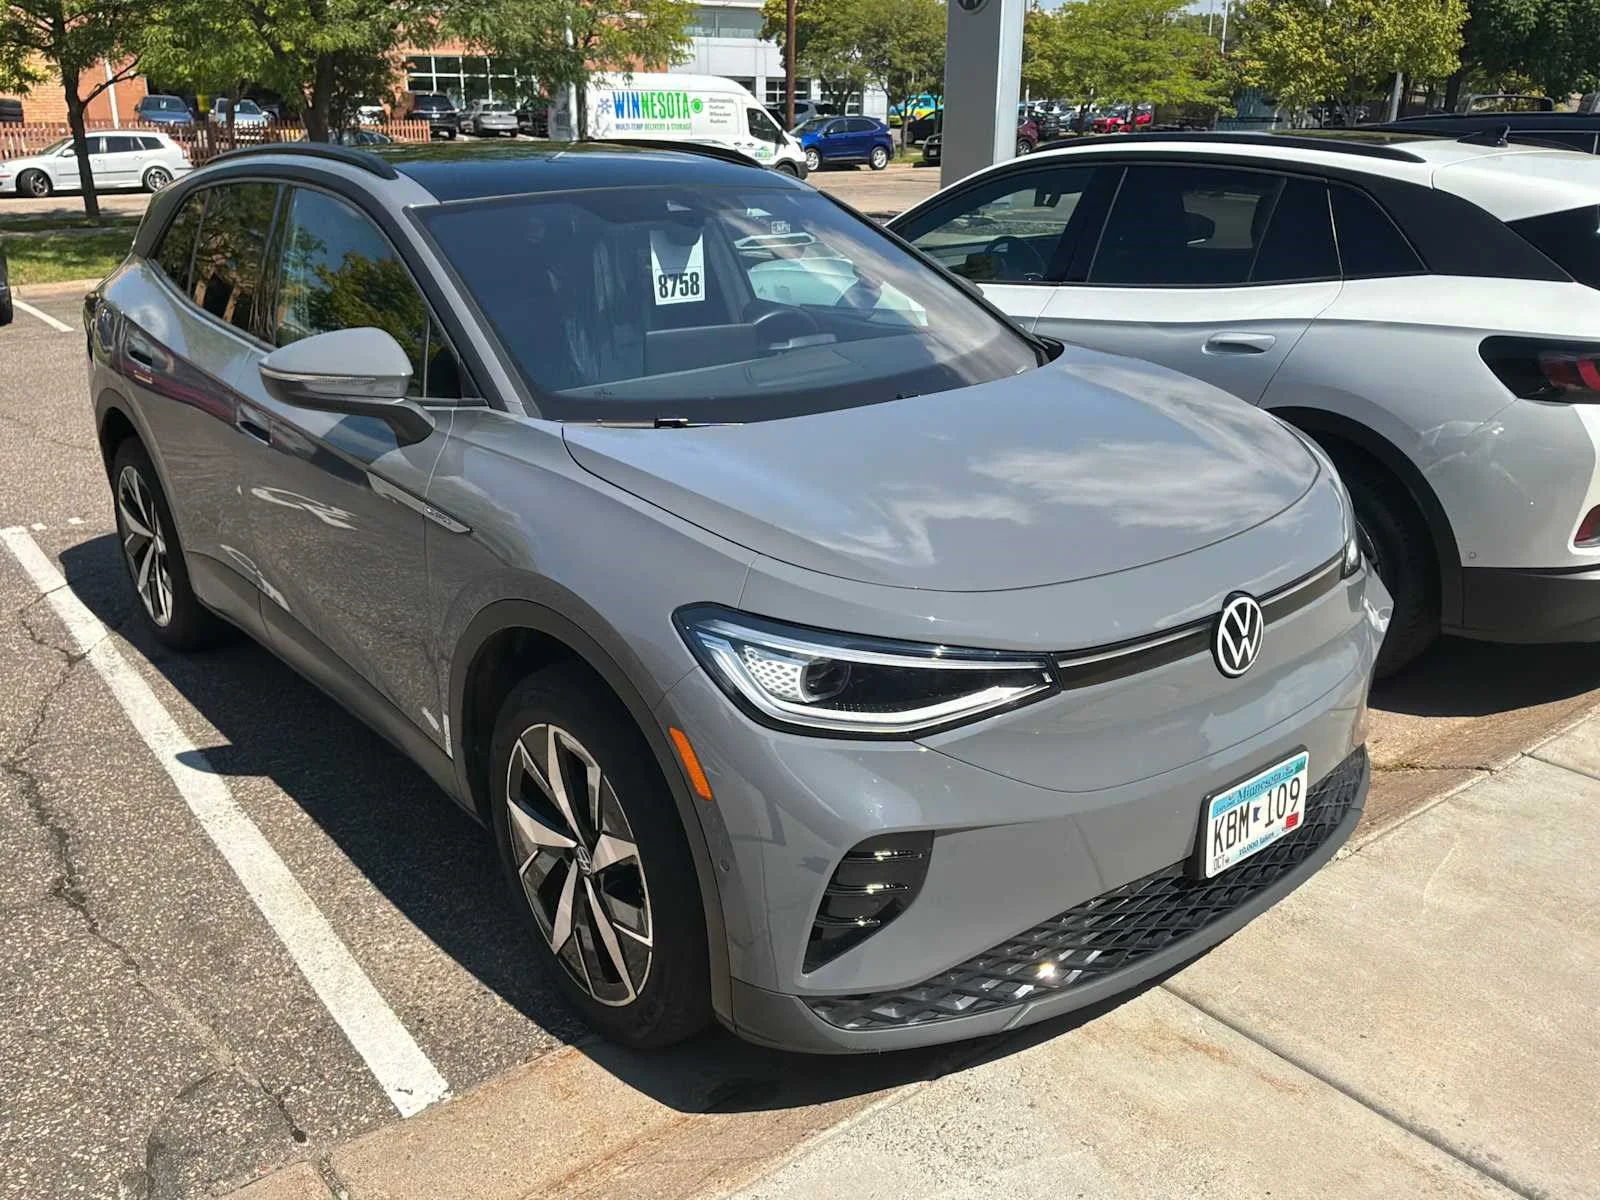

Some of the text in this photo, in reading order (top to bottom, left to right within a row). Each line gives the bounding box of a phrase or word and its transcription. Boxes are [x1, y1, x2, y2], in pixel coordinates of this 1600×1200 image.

[612, 91, 691, 119] WINNESOTA
[657, 271, 701, 299] 8758
[1213, 776, 1301, 857] KBM 109
